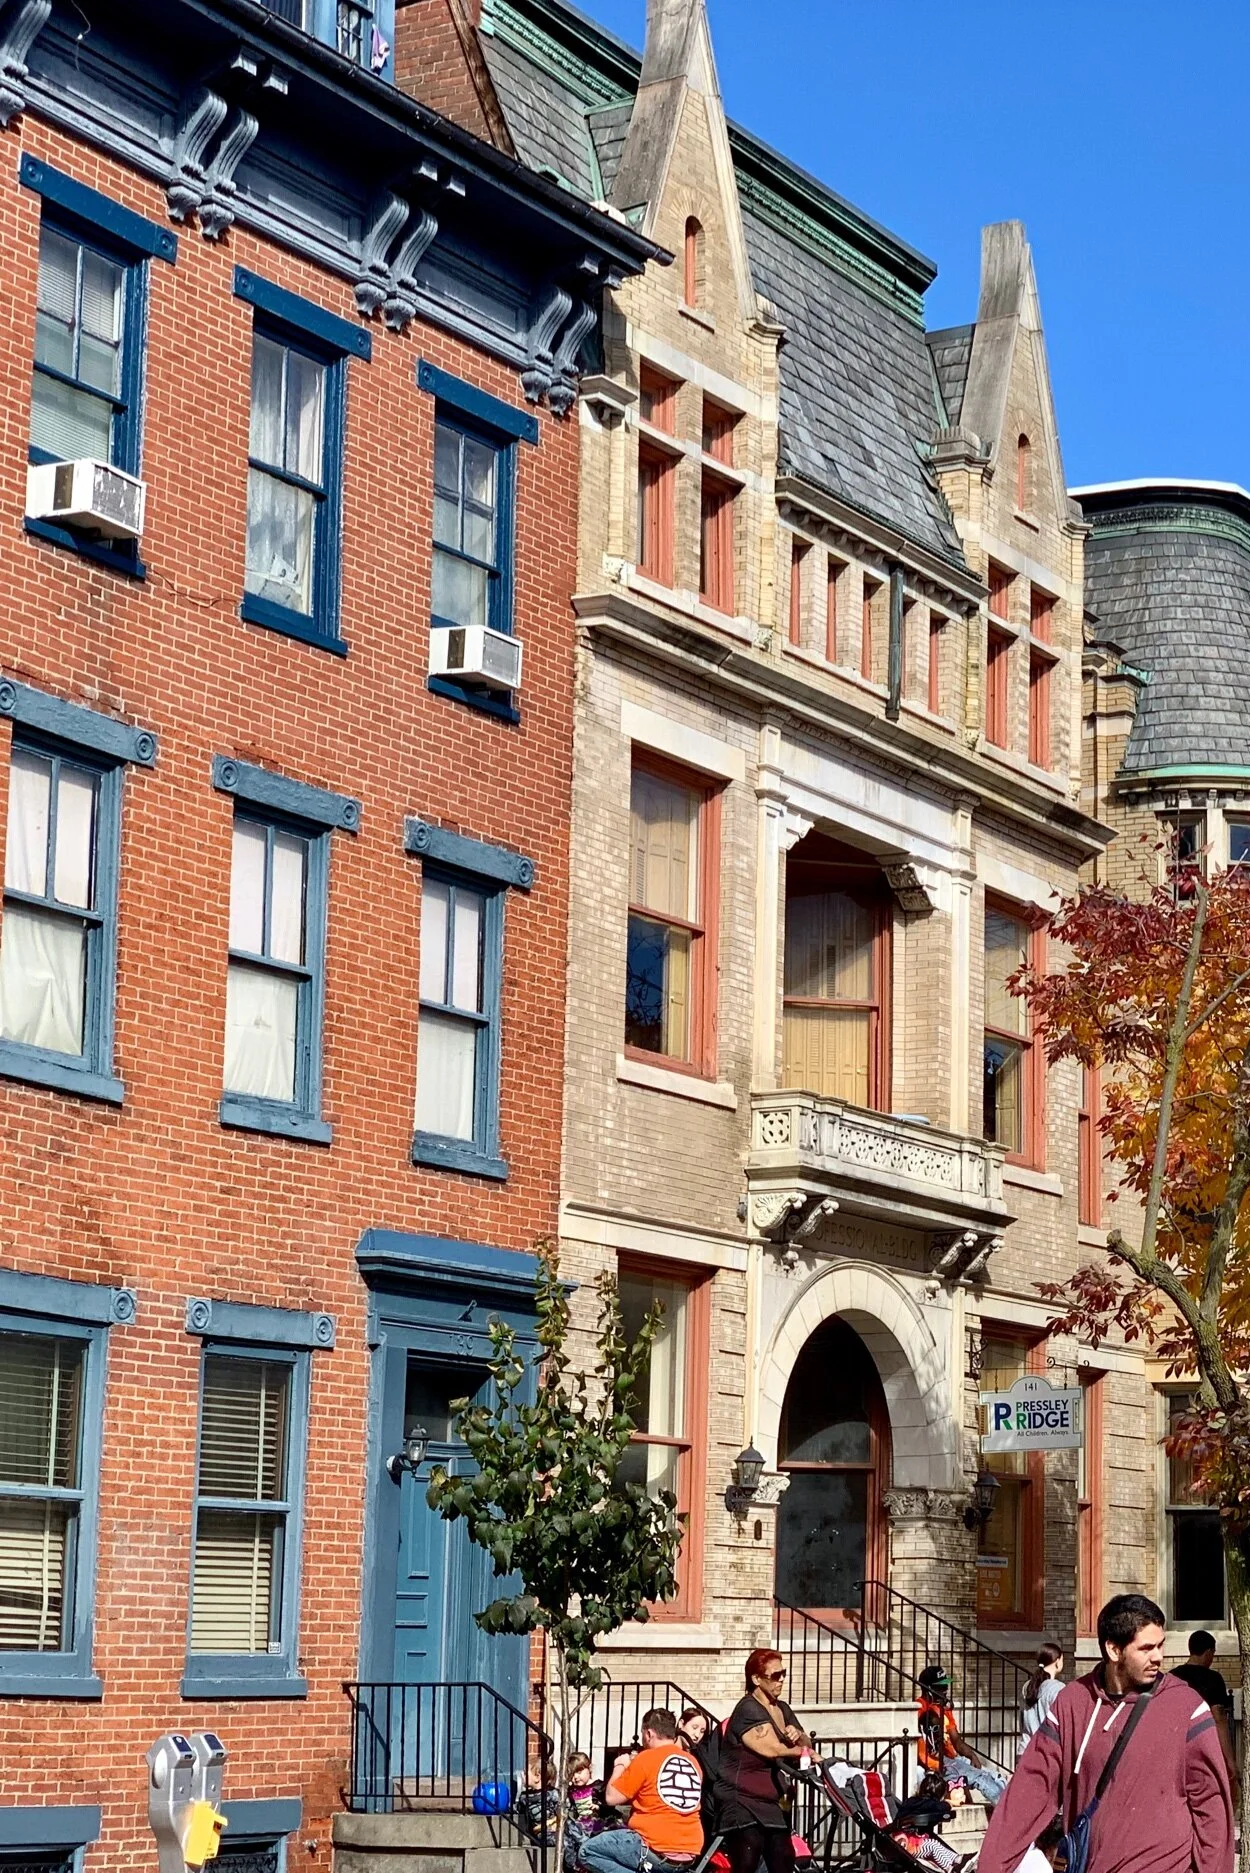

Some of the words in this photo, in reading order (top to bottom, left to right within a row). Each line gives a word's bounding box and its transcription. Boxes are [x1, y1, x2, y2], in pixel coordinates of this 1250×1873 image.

[1024, 1383, 1038, 1391] 141
[1016, 1399, 1069, 1412] PRESSLEY
[1016, 1411, 1069, 1430] RIDGE
